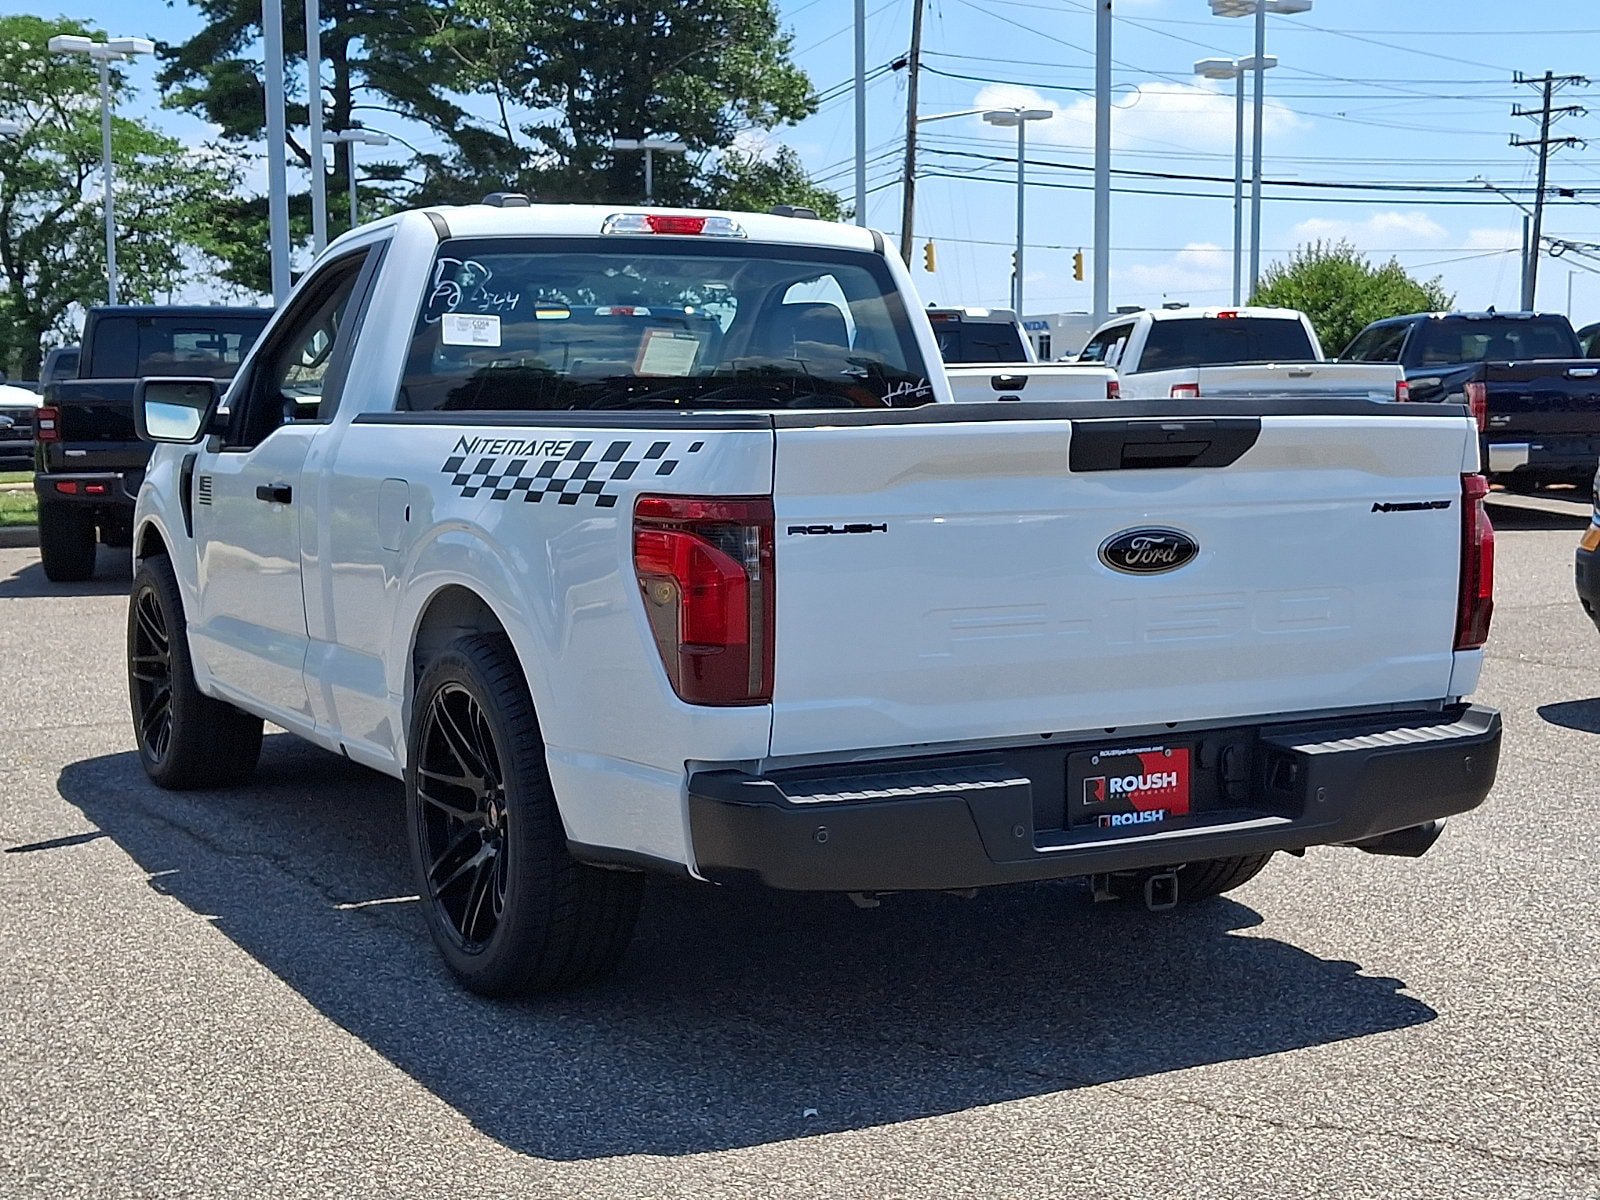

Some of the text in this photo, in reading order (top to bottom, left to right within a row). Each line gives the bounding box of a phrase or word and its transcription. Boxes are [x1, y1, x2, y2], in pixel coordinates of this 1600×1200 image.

[1024, 321, 1050, 330] NDA
[453, 434, 573, 456] NITEMARE
[787, 522, 888, 535] ROUSH
[1125, 536, 1179, 564] Ford
[1109, 771, 1177, 793] ROUSH
[1109, 787, 1177, 799] PERFORMANCE
[1111, 809, 1165, 826] ROUSH
